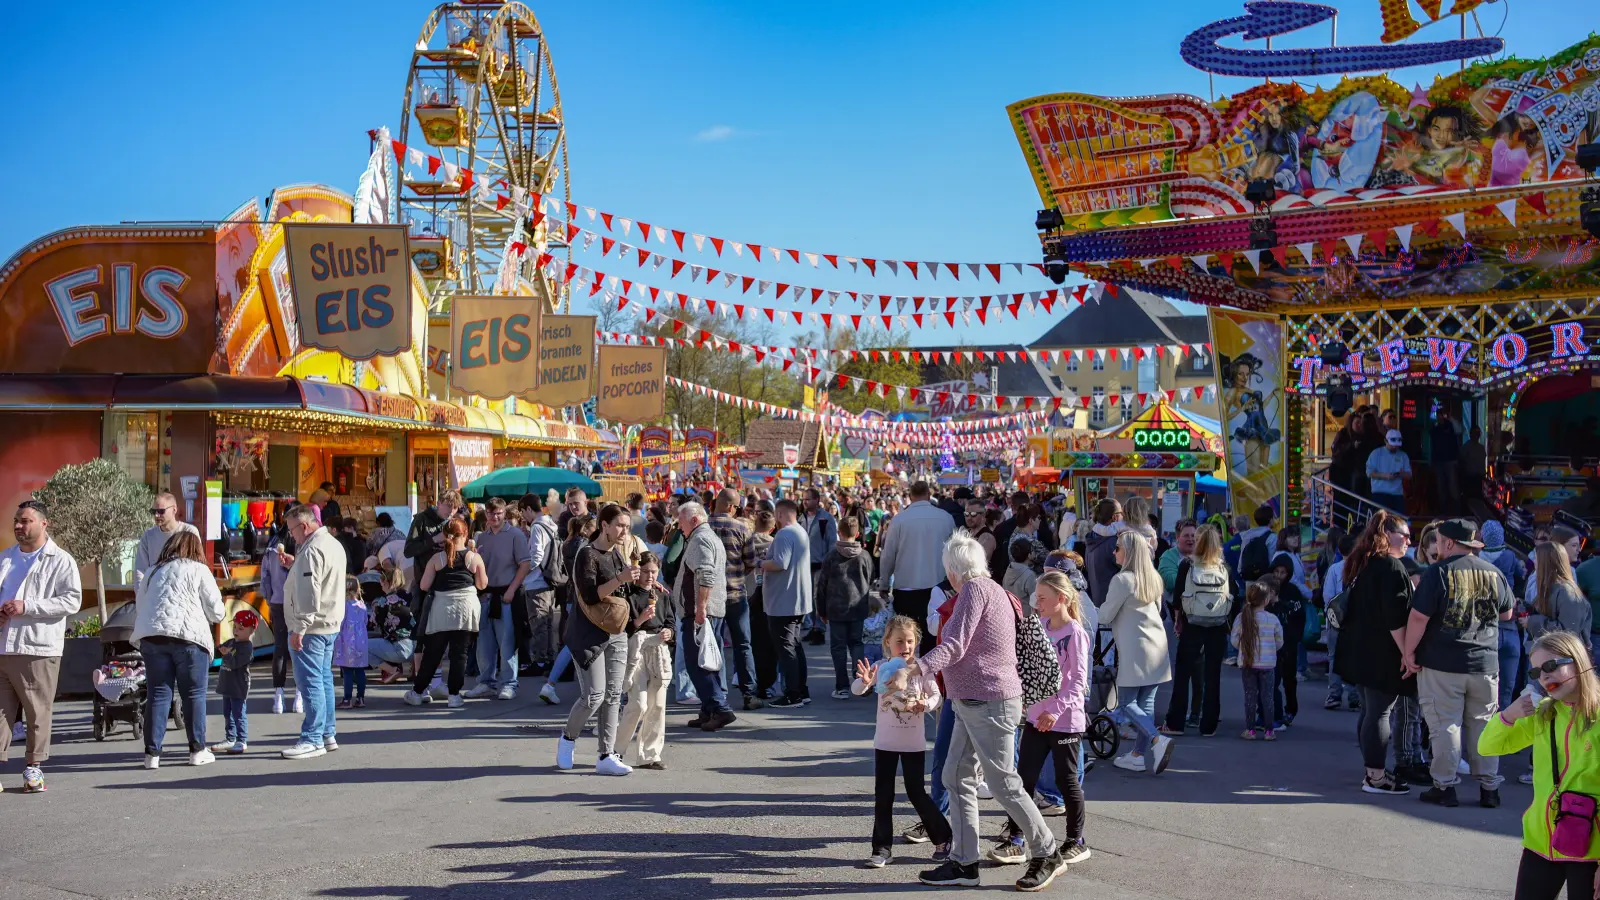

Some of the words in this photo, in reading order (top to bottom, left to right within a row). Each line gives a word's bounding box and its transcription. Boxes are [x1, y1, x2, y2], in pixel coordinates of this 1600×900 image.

[310, 235, 399, 282] Slush-
[42, 262, 191, 347] EIS
[316, 284, 394, 335] EIS
[460, 314, 532, 369] EIS
[602, 379, 660, 399] POPCORN
[611, 361, 653, 376] frisches
